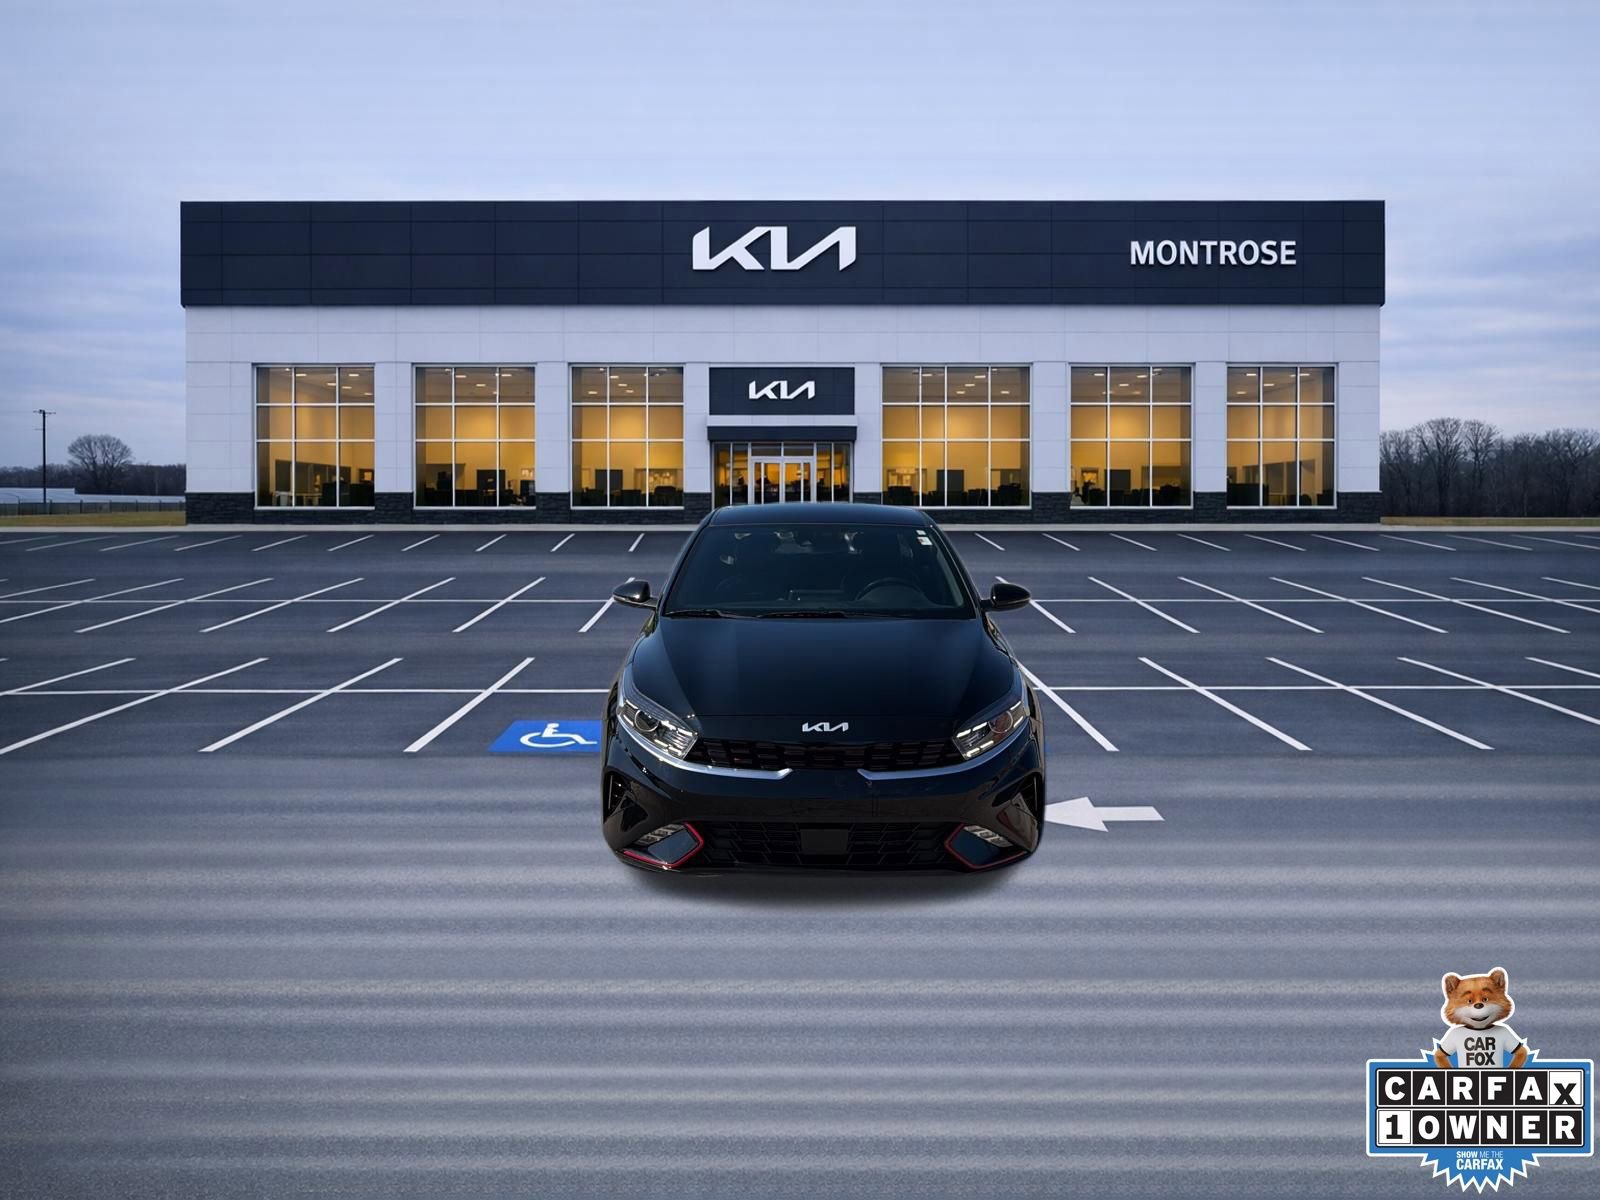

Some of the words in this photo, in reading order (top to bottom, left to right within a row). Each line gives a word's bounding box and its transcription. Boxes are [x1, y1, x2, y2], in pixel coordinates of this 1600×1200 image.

[692, 226, 856, 271] KIA
[1130, 240, 1296, 265] MONTROSE
[748, 380, 815, 399] KIA
[802, 722, 848, 732] KIA
